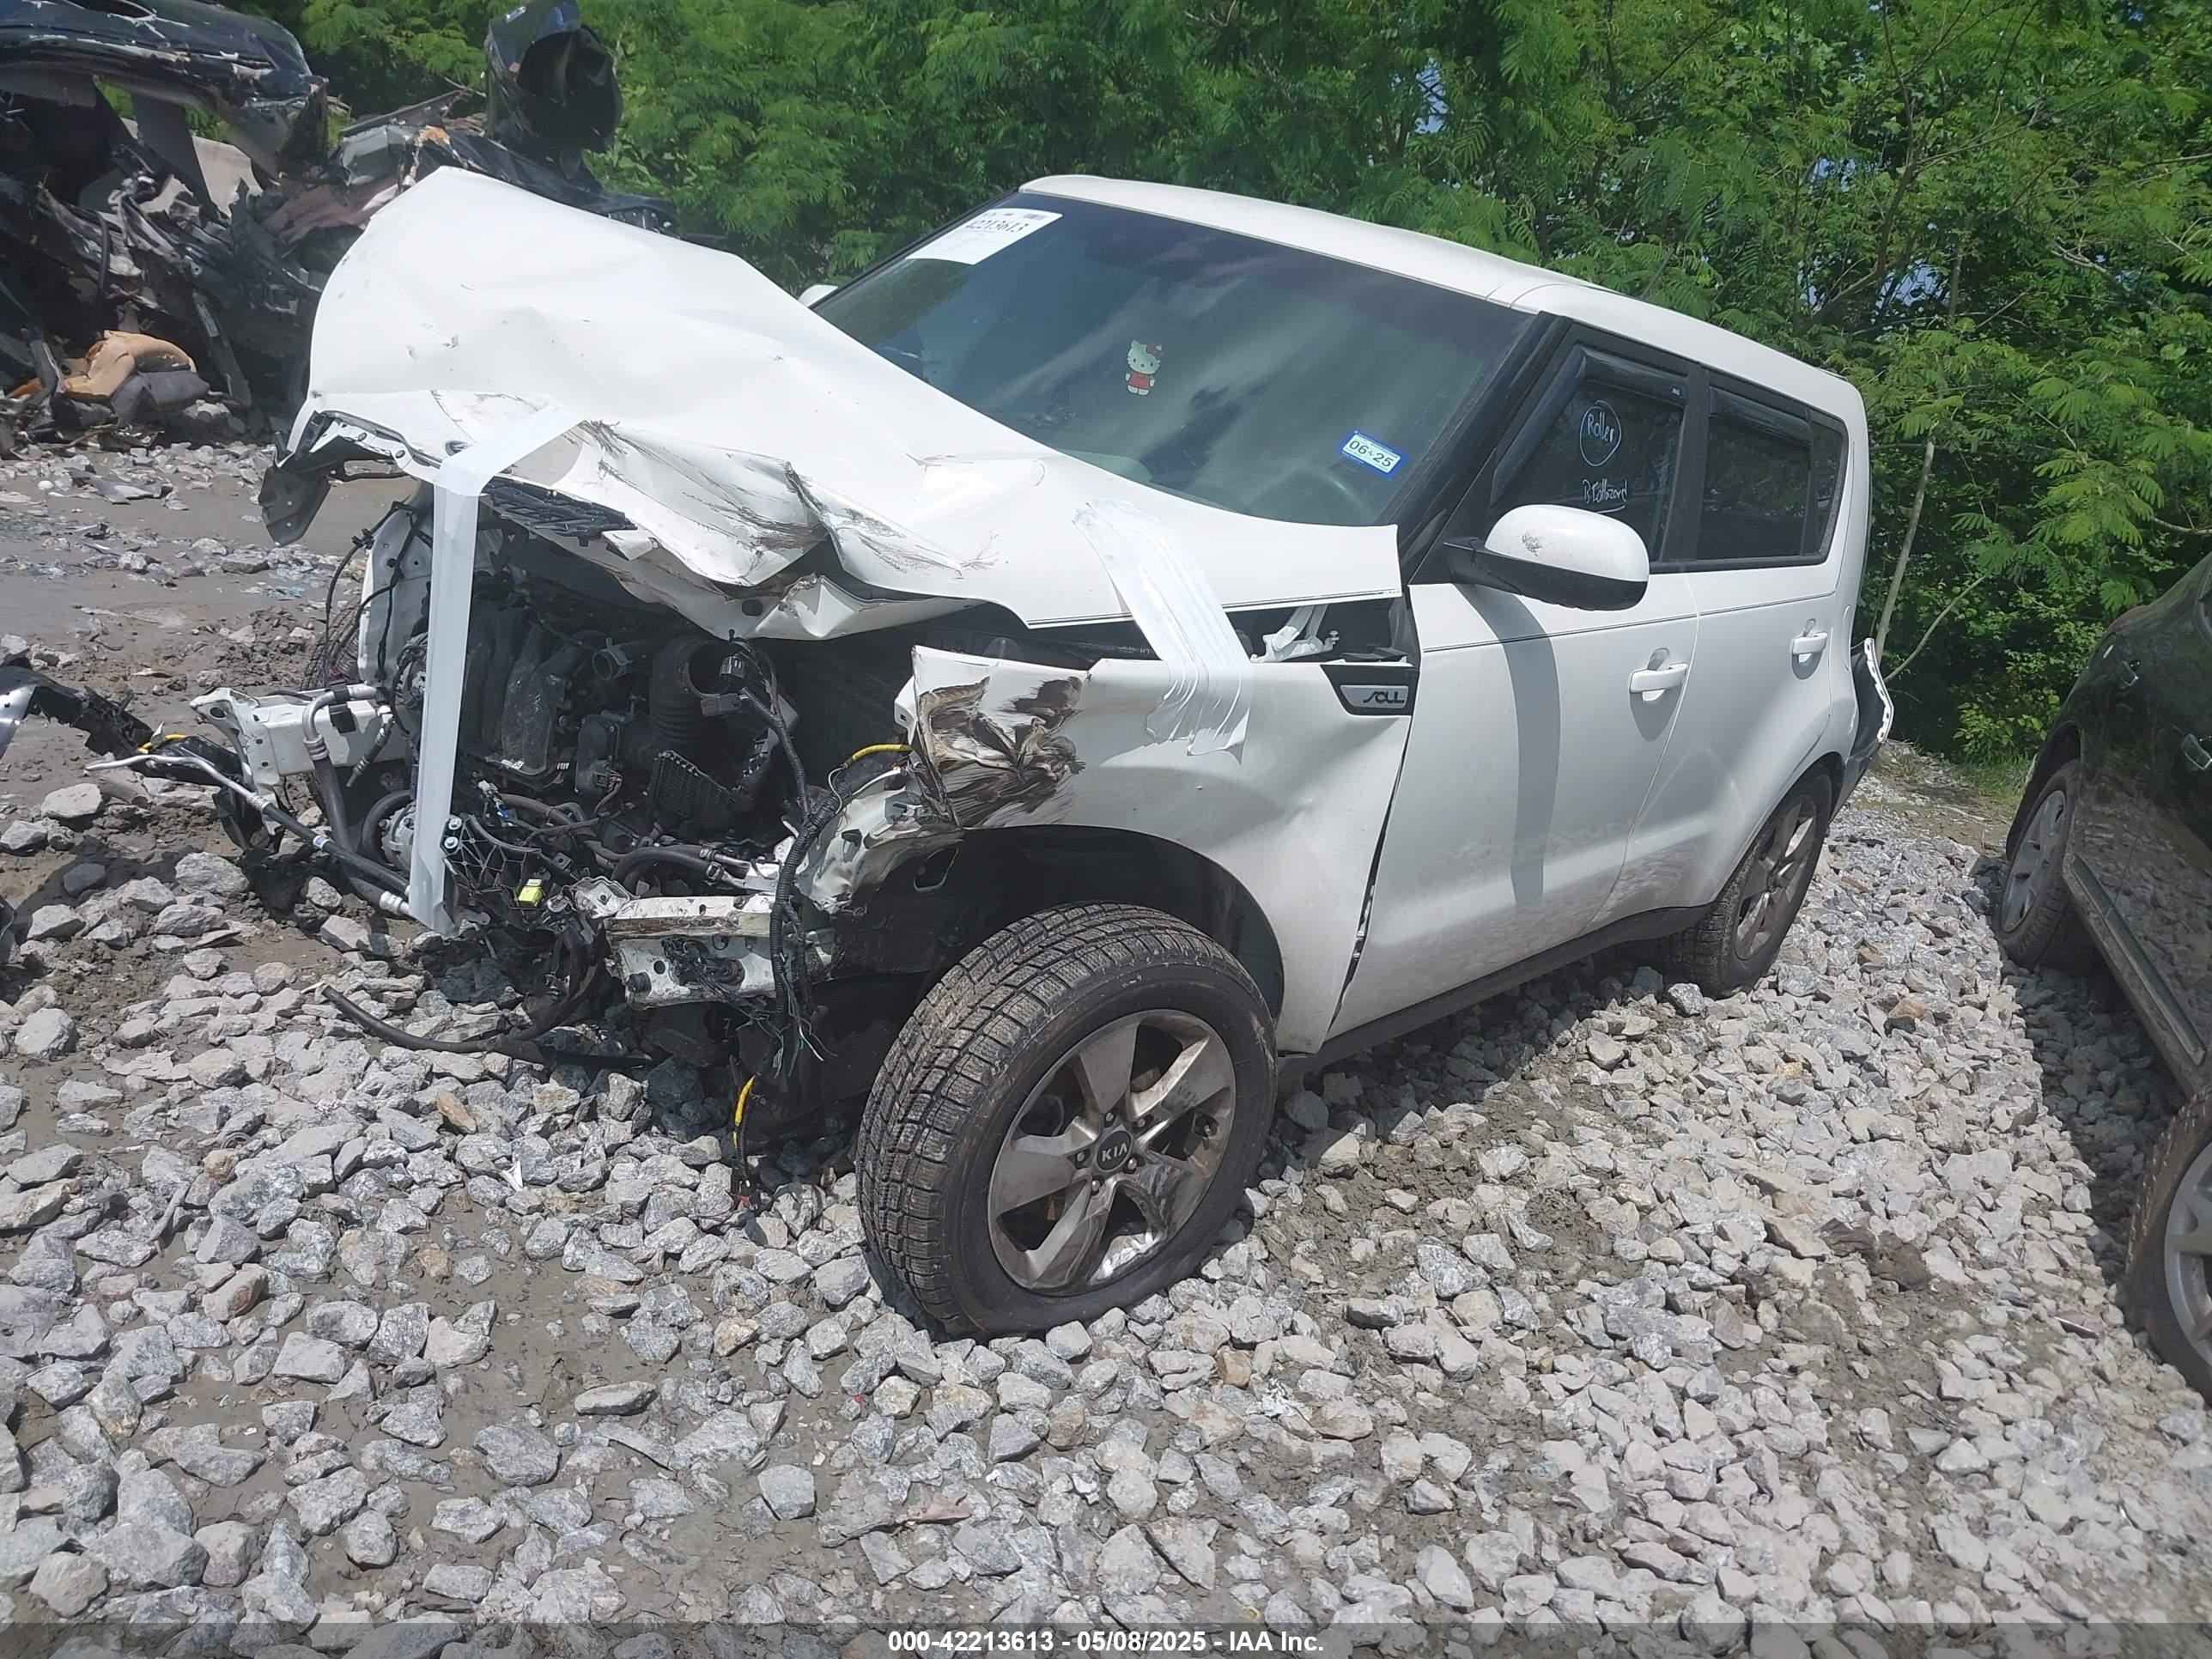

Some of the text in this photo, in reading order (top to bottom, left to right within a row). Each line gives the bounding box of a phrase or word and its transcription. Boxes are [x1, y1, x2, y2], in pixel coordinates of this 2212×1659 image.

[1588, 412, 1614, 442] Roller
[1363, 691, 1405, 703] SOUL
[1102, 1143, 1127, 1162] KIA
